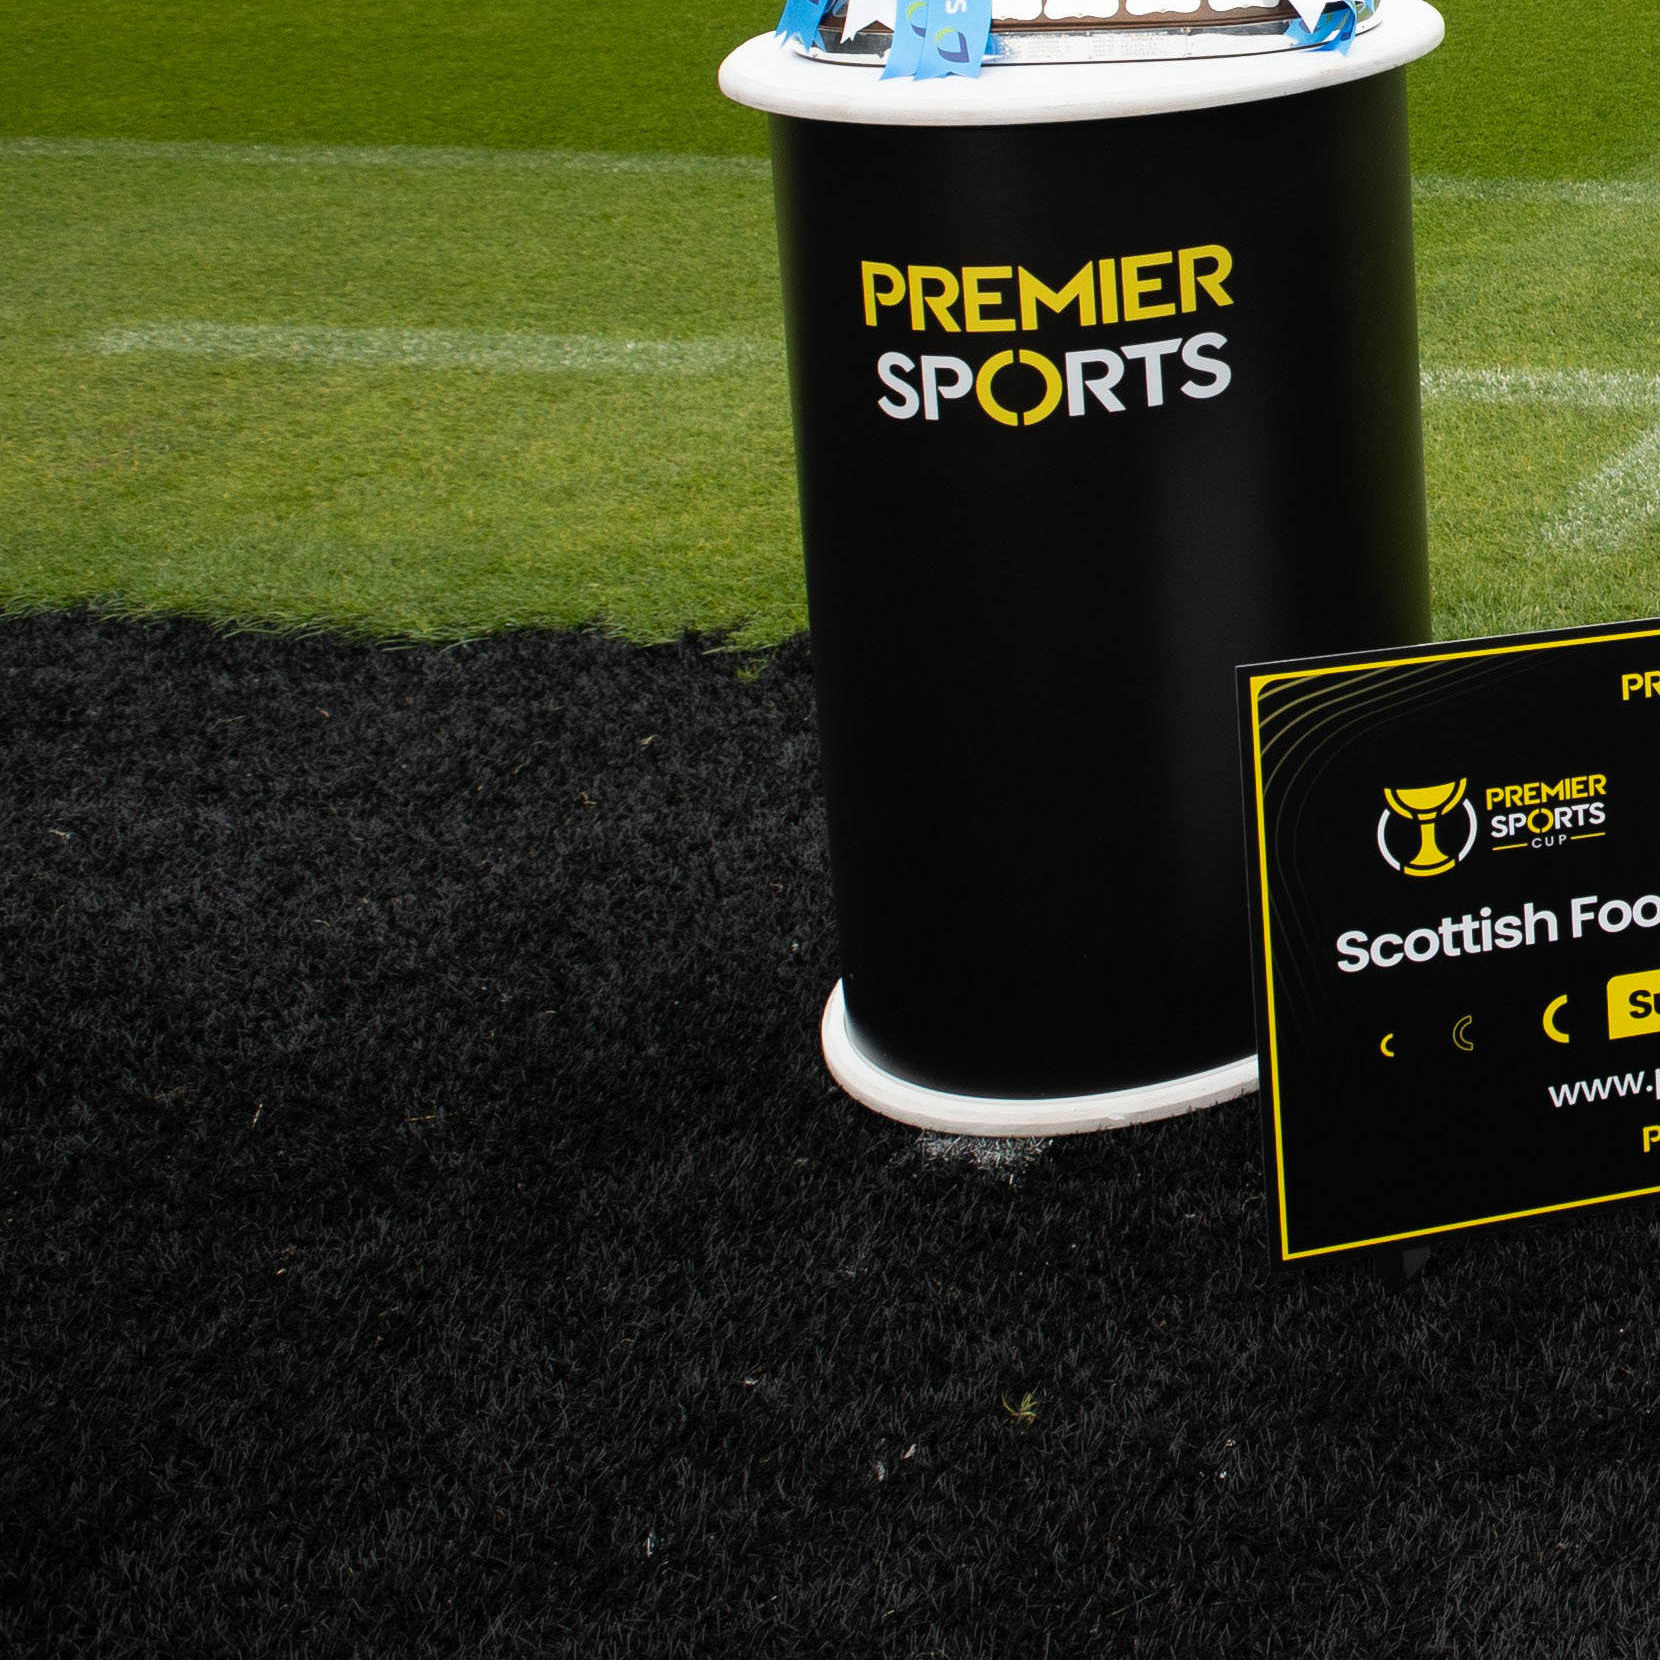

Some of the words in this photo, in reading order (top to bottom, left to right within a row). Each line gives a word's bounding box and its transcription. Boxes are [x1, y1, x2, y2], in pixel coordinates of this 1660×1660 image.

[861, 244, 1234, 332] PREMIER
[877, 332, 1232, 427] SPORTS
[1486, 774, 1607, 811] PREMIER
[1491, 802, 1606, 838] SPORTS
[1531, 834, 1567, 850] CUP
[1336, 905, 1558, 973] Scottish
